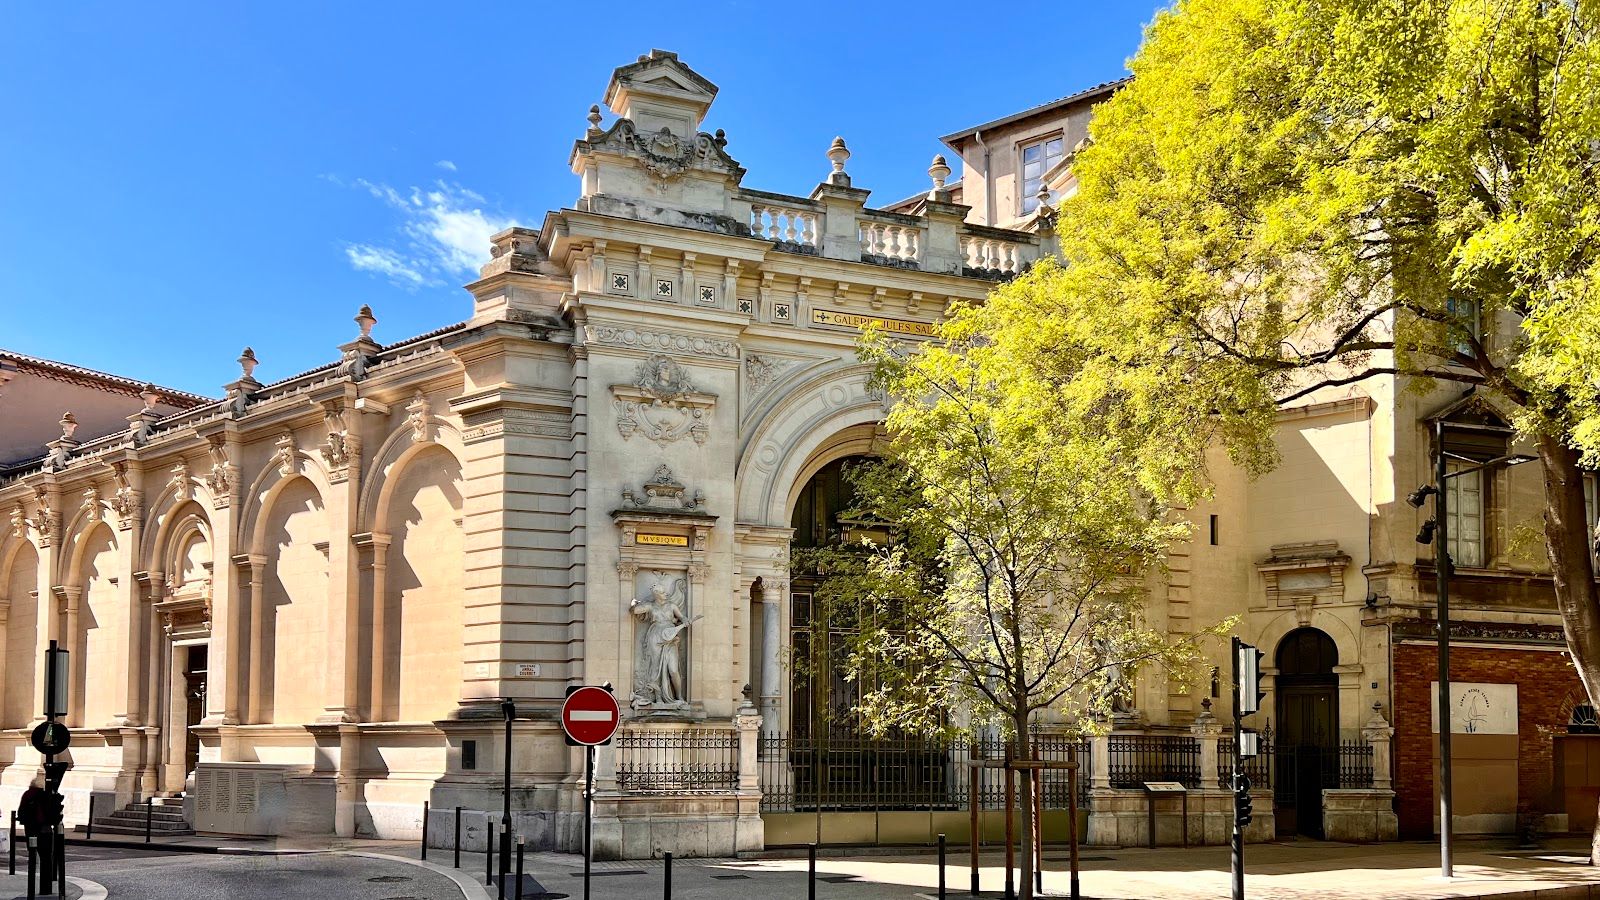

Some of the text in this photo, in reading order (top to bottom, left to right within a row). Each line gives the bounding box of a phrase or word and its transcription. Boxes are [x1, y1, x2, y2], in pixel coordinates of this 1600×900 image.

[834, 314, 934, 335] GALERI JULES SAL
